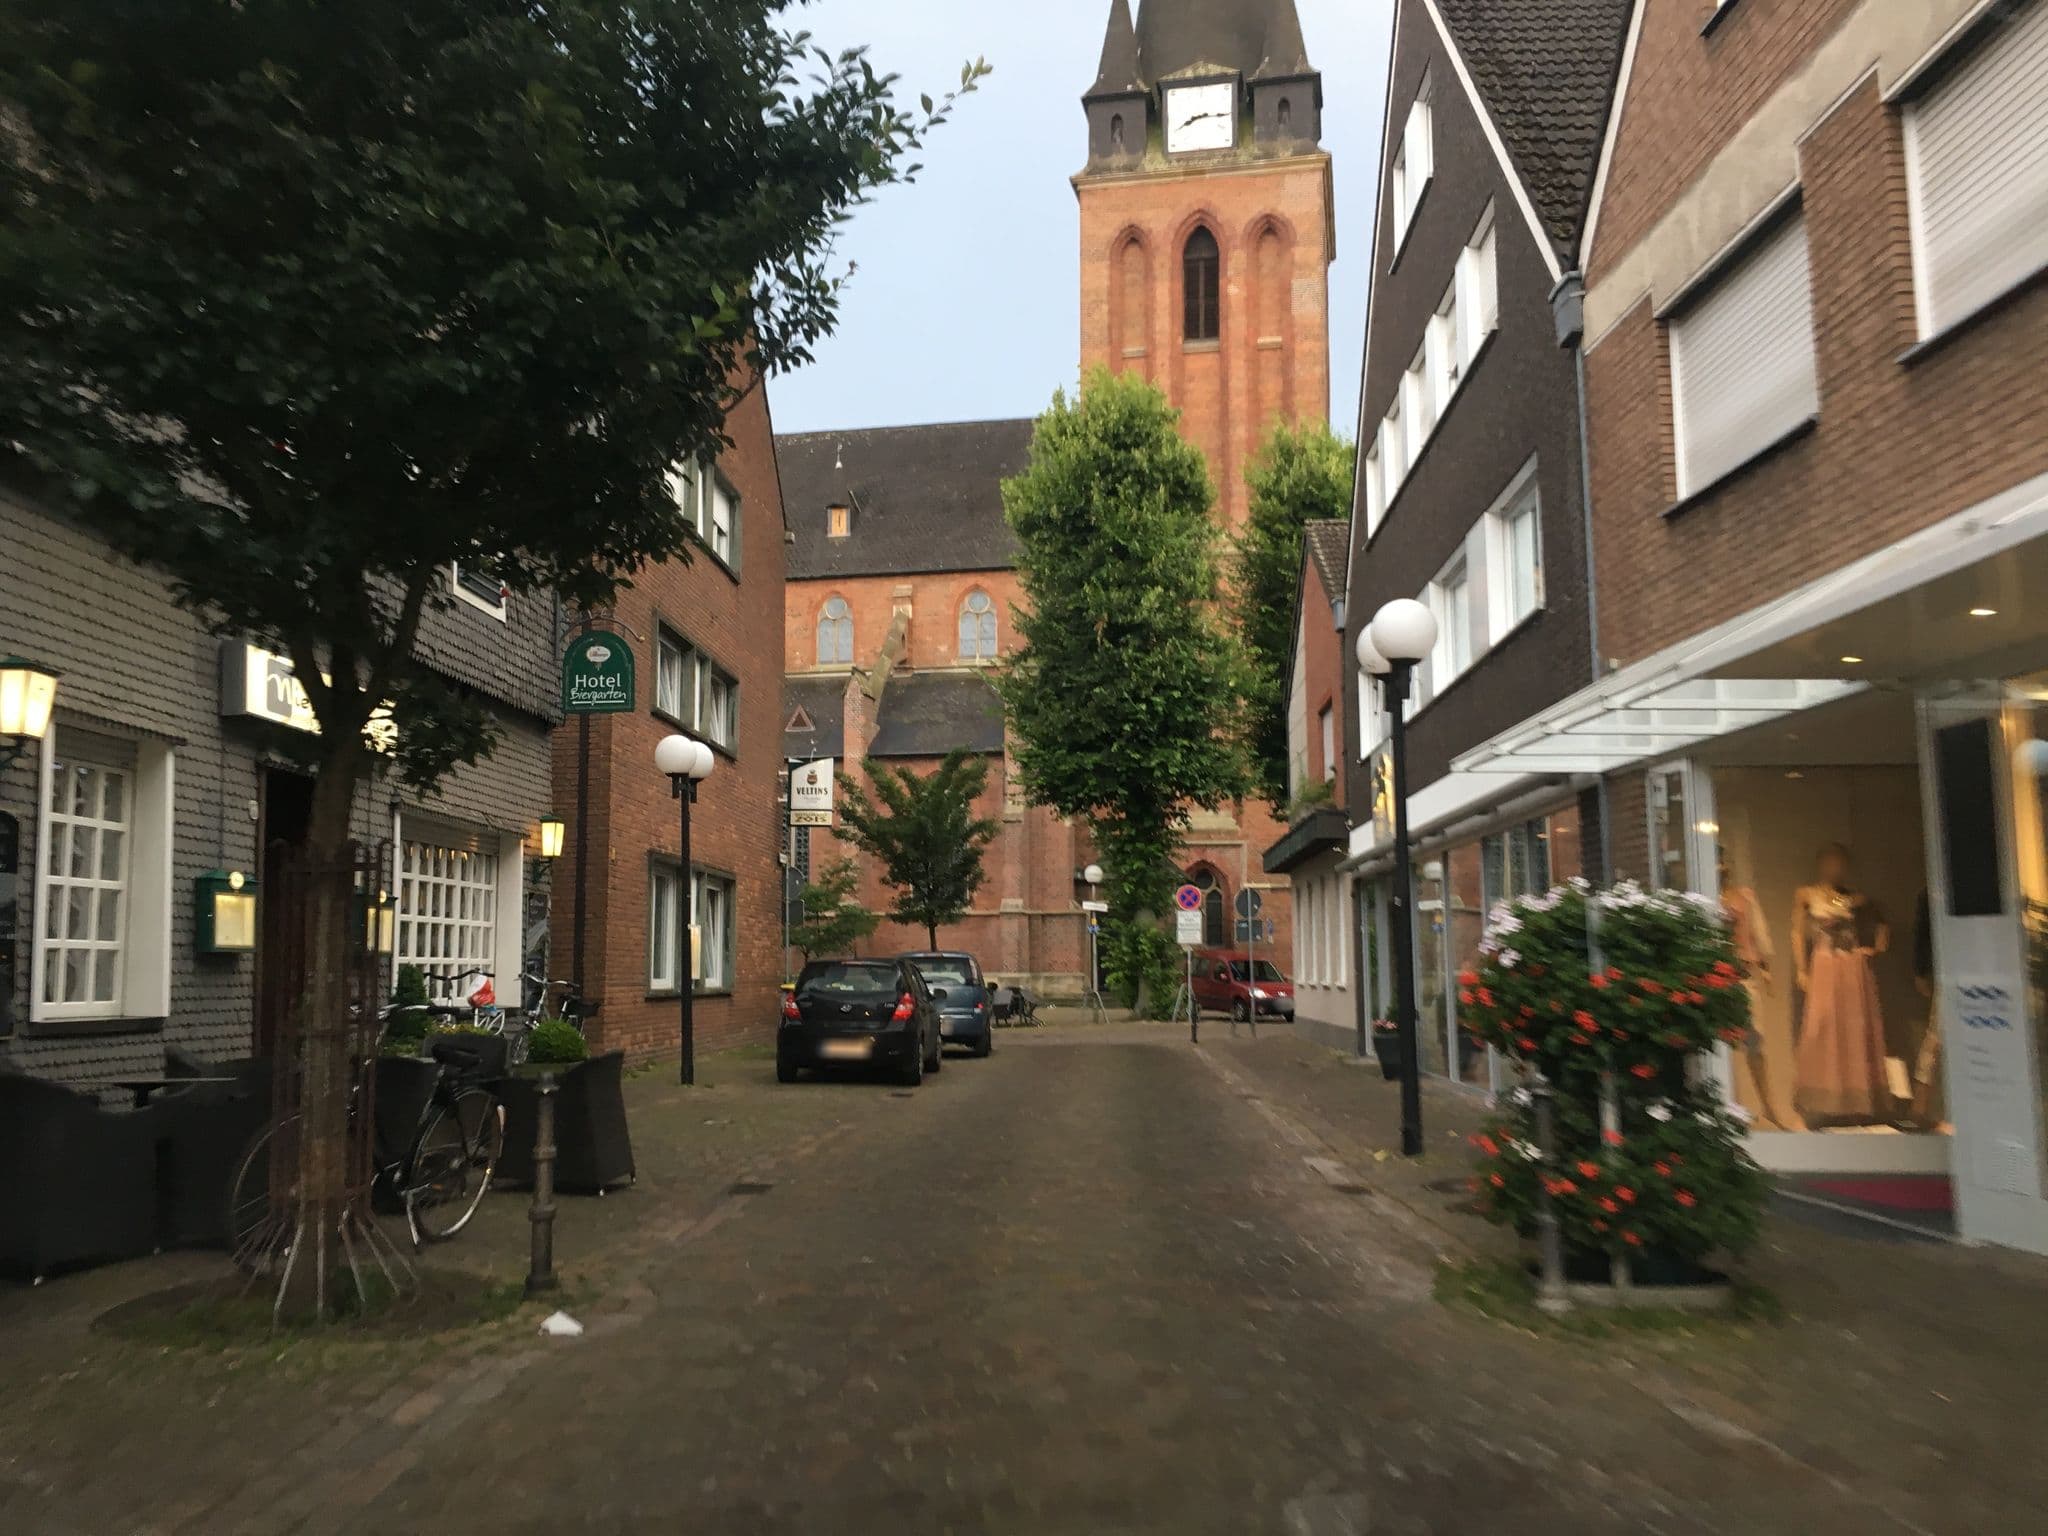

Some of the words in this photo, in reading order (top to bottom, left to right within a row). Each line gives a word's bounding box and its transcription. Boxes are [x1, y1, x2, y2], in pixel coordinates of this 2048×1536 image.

[575, 673, 621, 688] Hotel
[570, 687, 626, 704] Biergarten
[796, 787, 828, 795] VELTINS
